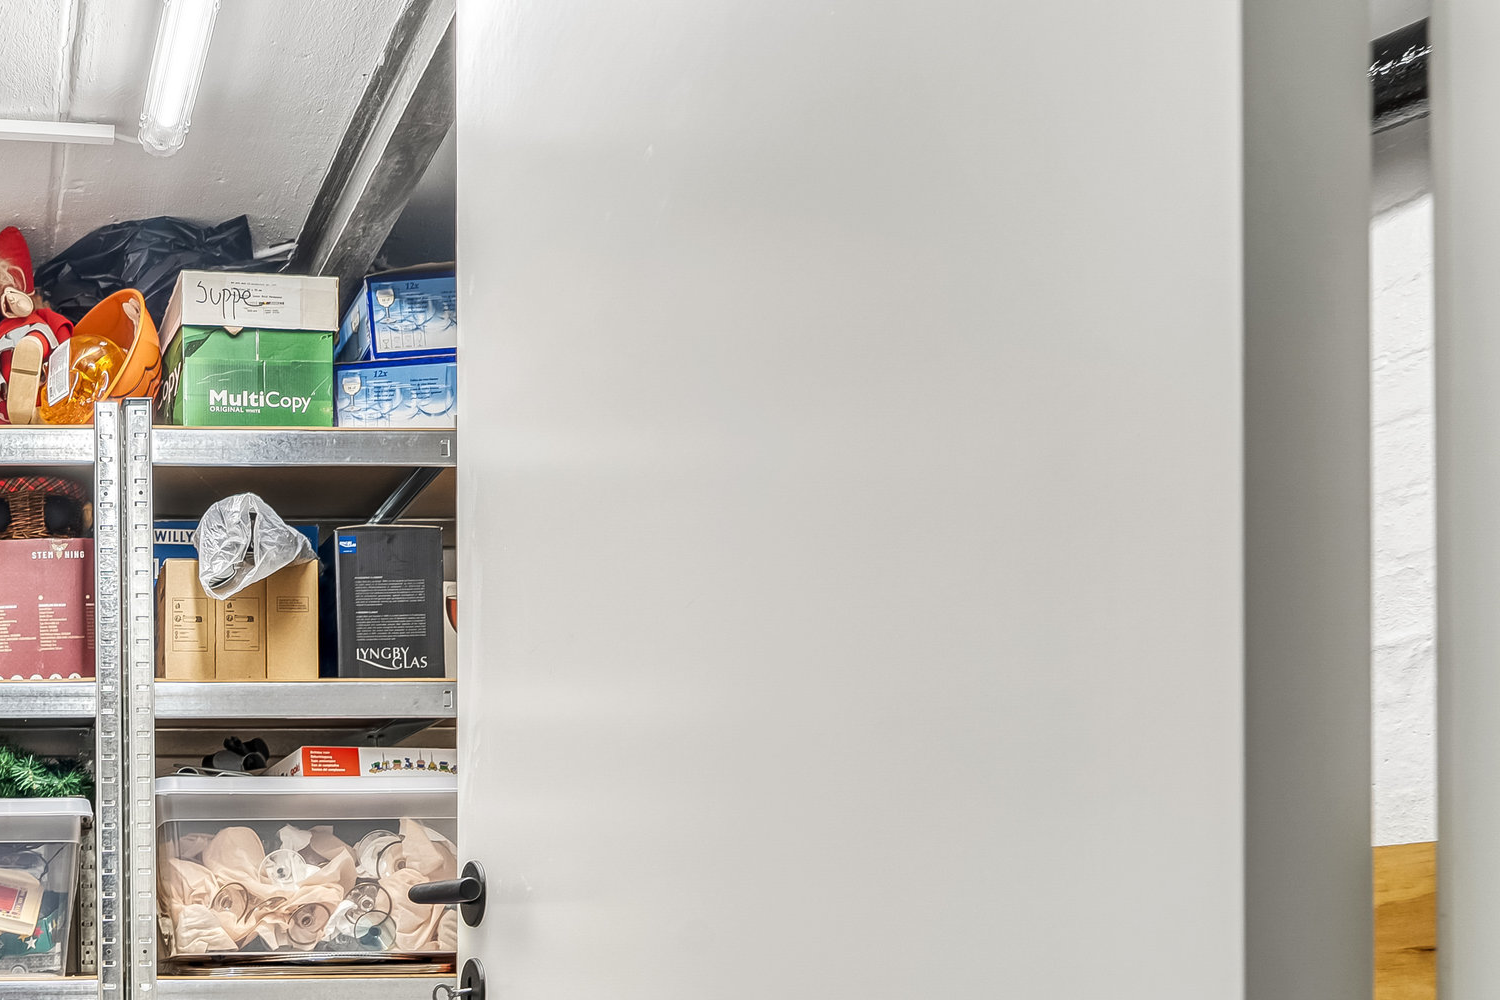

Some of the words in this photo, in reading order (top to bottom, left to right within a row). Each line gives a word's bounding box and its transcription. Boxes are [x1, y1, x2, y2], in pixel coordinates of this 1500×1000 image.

[196, 281, 263, 320] Suppe
[373, 370, 388, 378] 12x
[209, 389, 311, 413] MultiCopy
[356, 647, 410, 660] LYNGBY
[392, 656, 428, 669] GLAS
